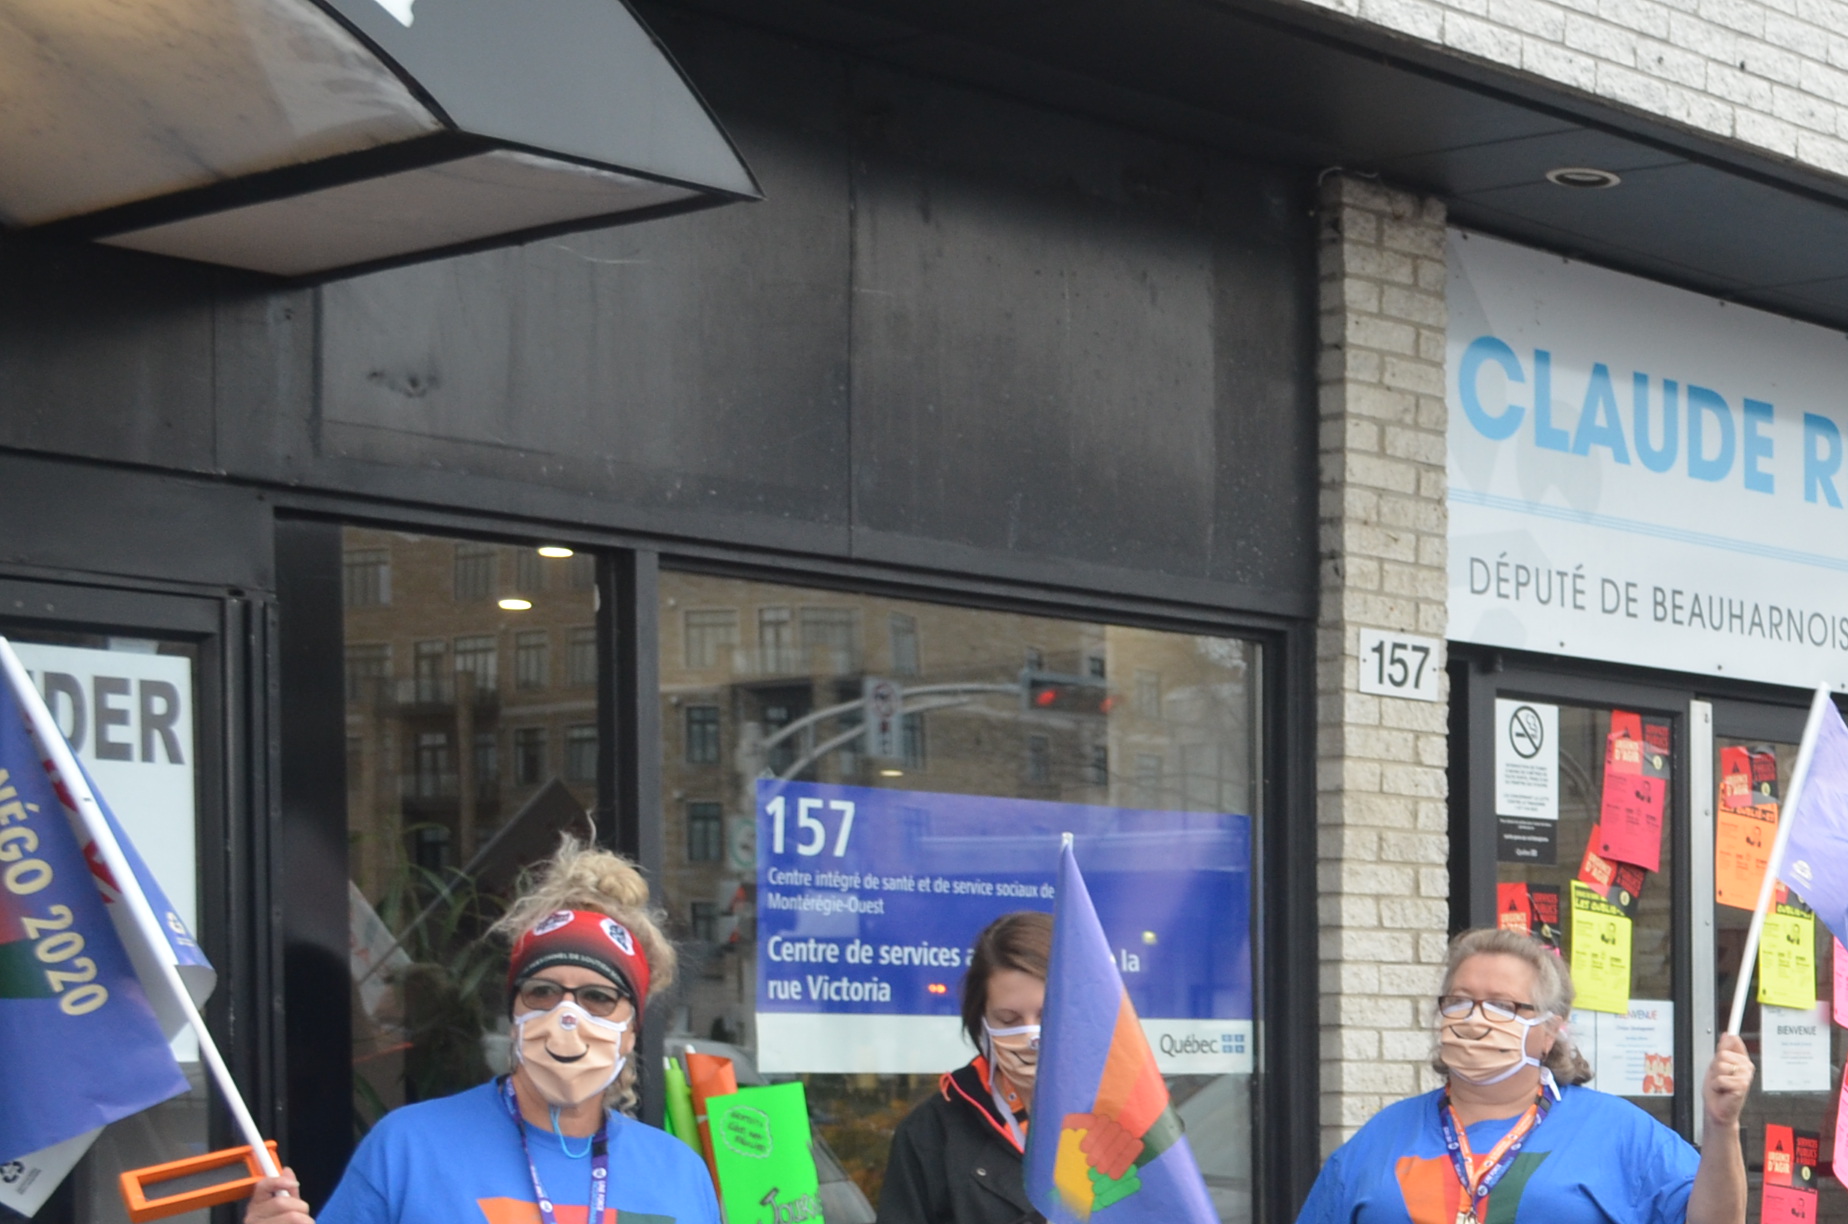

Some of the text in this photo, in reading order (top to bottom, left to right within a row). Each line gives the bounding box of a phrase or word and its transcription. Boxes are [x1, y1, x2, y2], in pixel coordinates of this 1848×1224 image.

[1457, 335, 1775, 494] CLAUDE
[1470, 552, 1586, 613] DÉPUTÉ
[1602, 578, 1640, 619] DE
[1370, 639, 1431, 690] 157
[26, 670, 185, 764] DER
[765, 795, 856, 858] 157
[767, 867, 1055, 899] Centre intégré de santé et de service sociaux de
[767, 892, 885, 916] Montérégie-Ouest
[21, 903, 109, 1018] 2020
[767, 936, 840, 963] Centre
[846, 938, 874, 965] de
[879, 941, 961, 967] services
[1121, 949, 1140, 972] la
[767, 975, 891, 1002] rue Victoria
[1160, 1033, 1218, 1057] Québec
[1777, 1024, 1817, 1036] BIENVENUE
